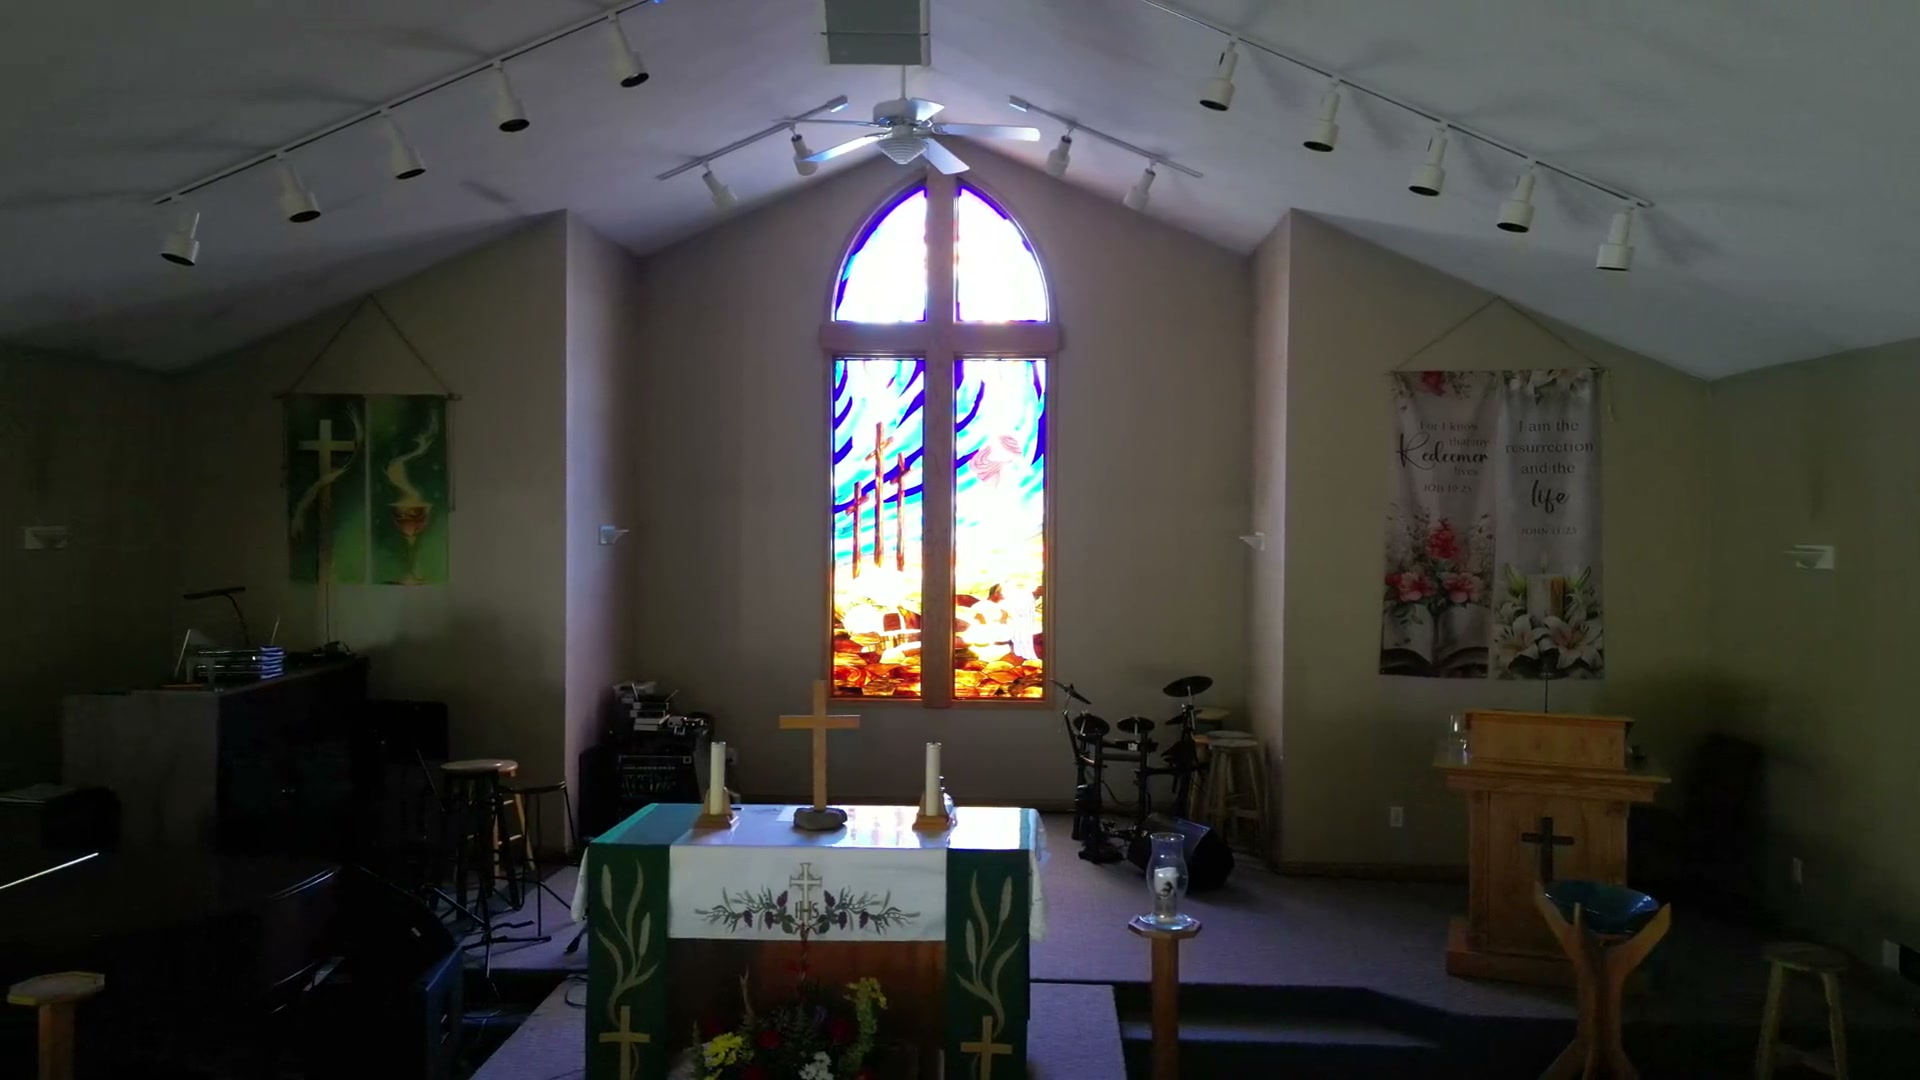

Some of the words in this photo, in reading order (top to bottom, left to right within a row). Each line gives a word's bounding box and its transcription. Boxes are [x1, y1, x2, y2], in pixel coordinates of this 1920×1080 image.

[1450, 421, 1478, 431] know
[1528, 421, 1550, 432] am
[1556, 419, 1579, 431] the
[1397, 433, 1488, 470] Redeemer
[1505, 441, 1594, 453] resurrection
[1521, 462, 1548, 474] and
[1552, 462, 1575, 474] the
[1531, 479, 1568, 514] life
